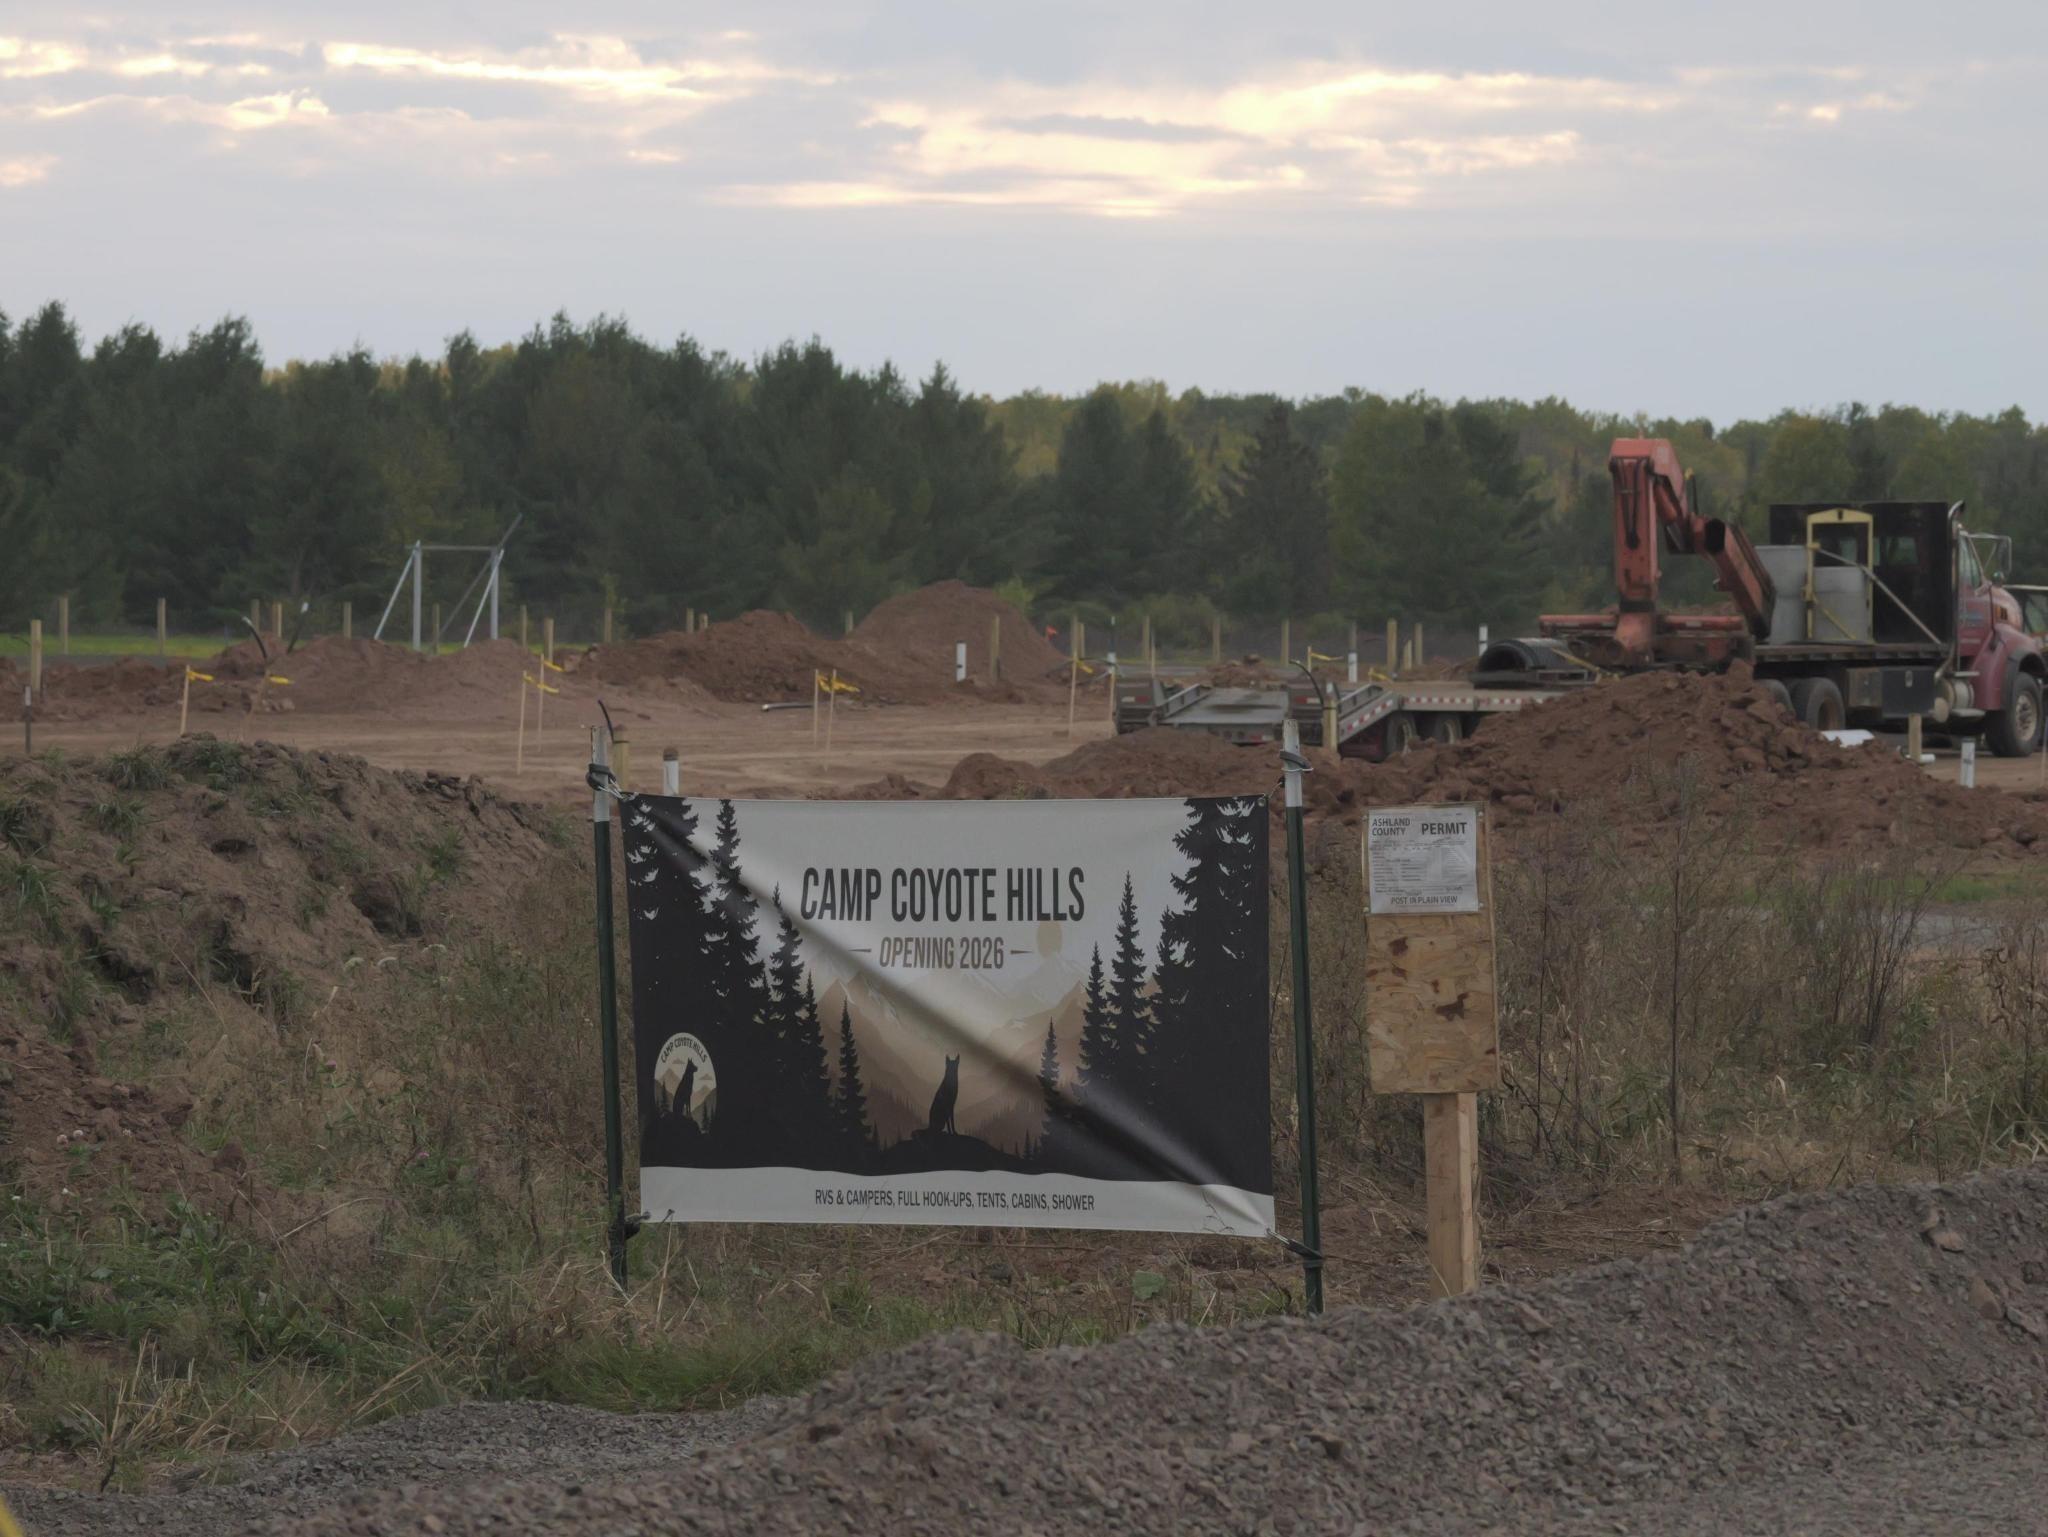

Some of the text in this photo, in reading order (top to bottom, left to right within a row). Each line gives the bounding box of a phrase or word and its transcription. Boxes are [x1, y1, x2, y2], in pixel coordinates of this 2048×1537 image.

[1372, 818, 1410, 827] ASHLAND
[1421, 822, 1467, 835] PERMIT
[1372, 827, 1406, 836] COUNTY
[801, 867, 1085, 922] CAMP COYOTE HILLS
[1391, 896, 1408, 904] POST
[1418, 896, 1439, 904] PLAIN
[1440, 896, 1458, 904] VIEW
[879, 937, 1004, 969] OPENING 2026
[661, 1041, 674, 1063] CAMP
[692, 1041, 708, 1063] HILLS
[815, 1189, 1095, 1212] RVS & CAMPERS, FULL HOOK-UPS, TENTS, CABINS, SHOWER
